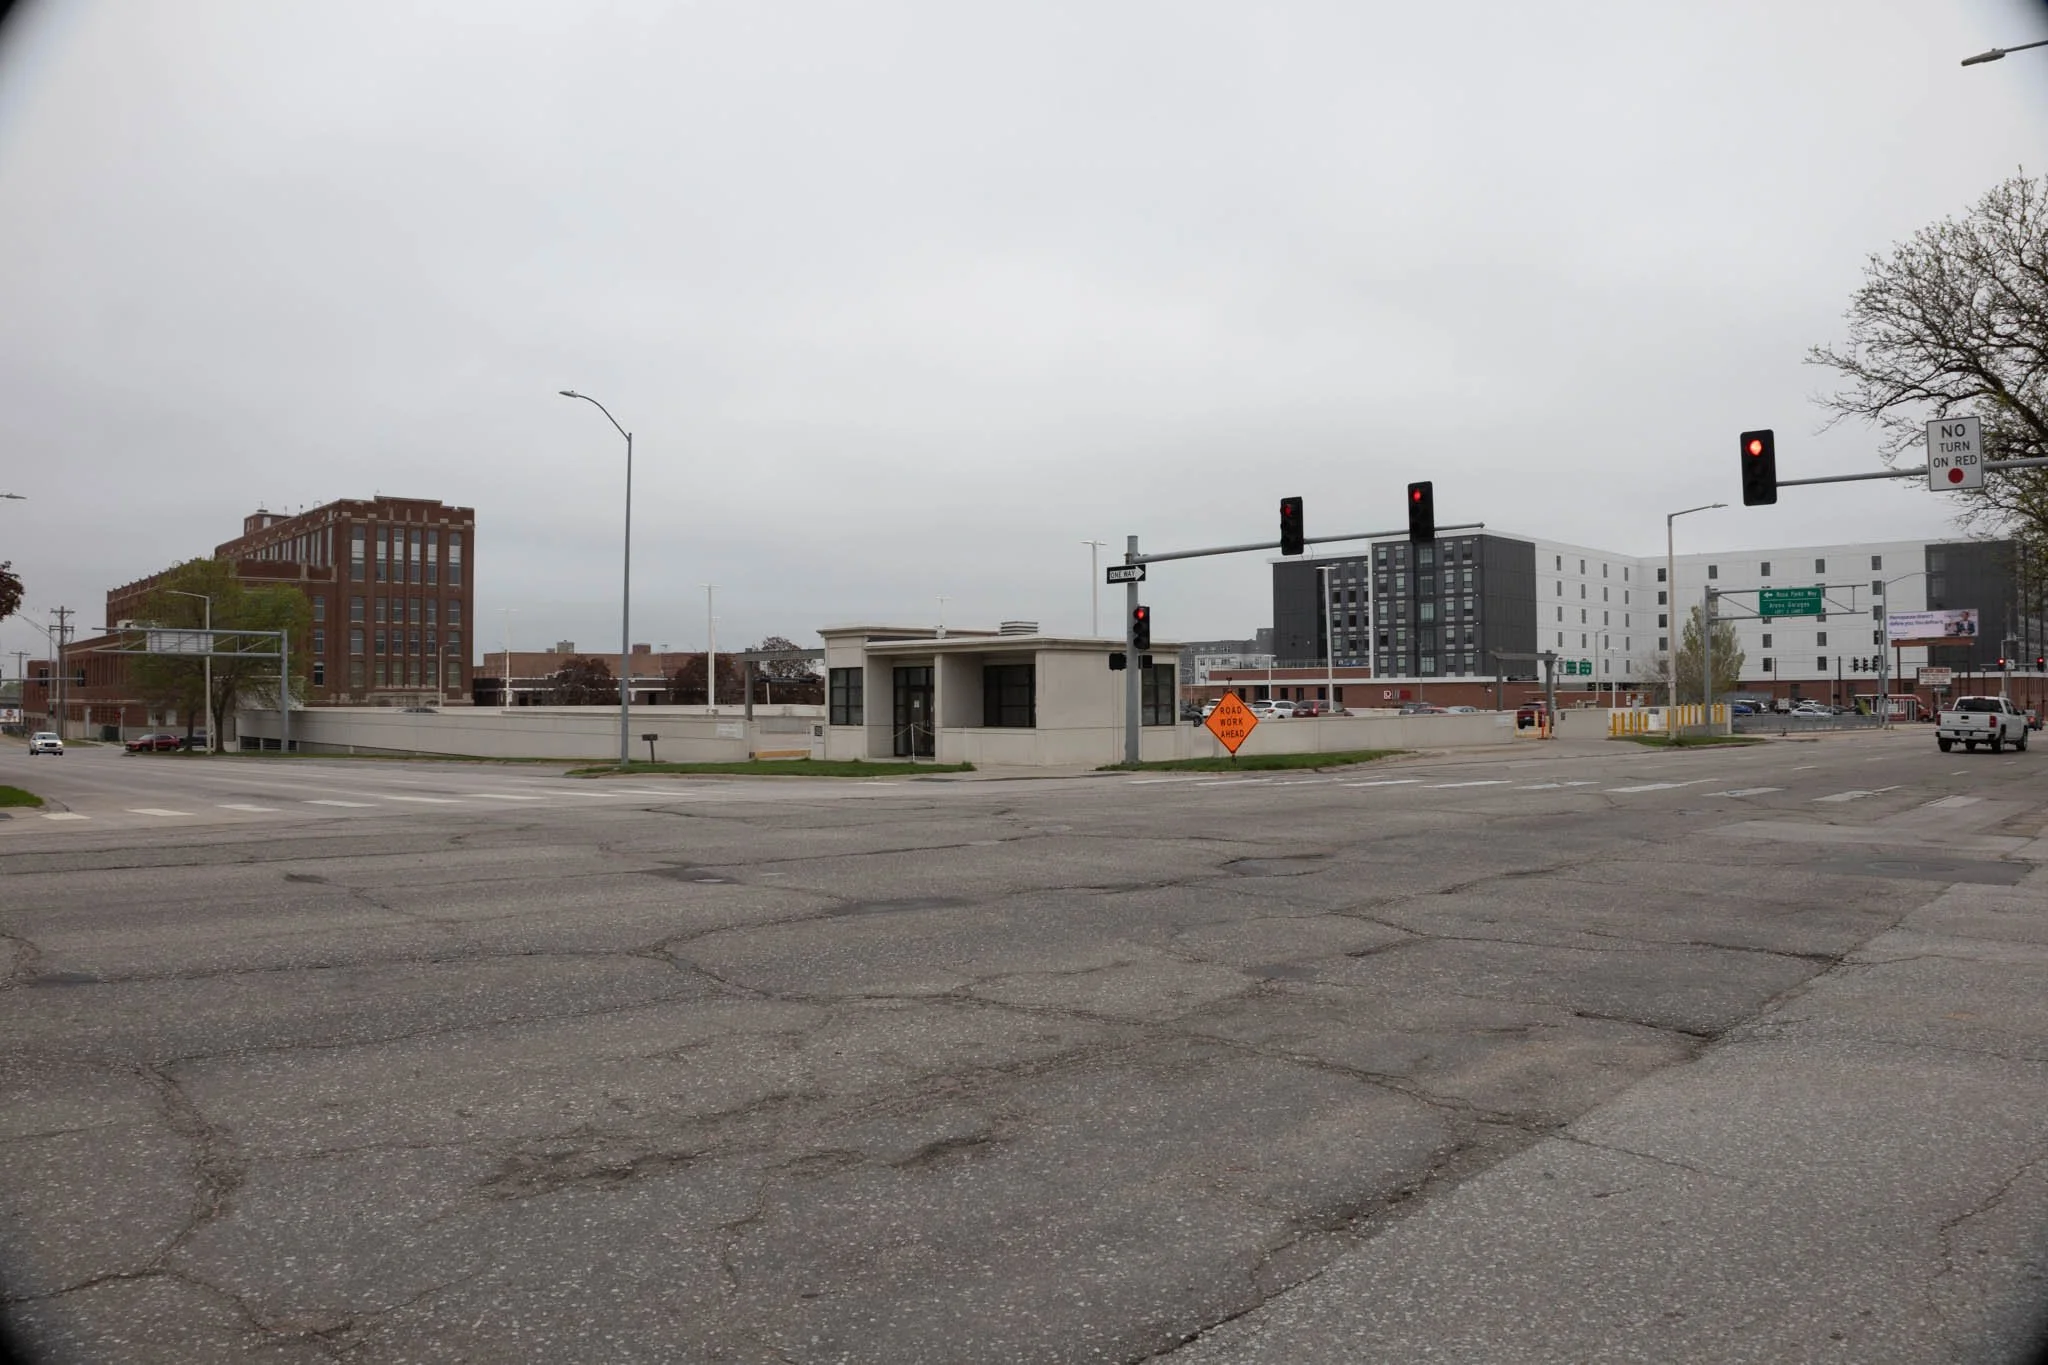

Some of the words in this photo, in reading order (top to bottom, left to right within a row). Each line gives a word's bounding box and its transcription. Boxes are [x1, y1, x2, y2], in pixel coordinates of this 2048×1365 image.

[1941, 424, 1965, 438] NO
[1939, 441, 1970, 453] TURN
[1933, 457, 1948, 468] ON
[1955, 455, 1977, 466] RED
[1124, 569, 1136, 577] WAY
[1220, 706, 1242, 714] ROAD
[1220, 718, 1243, 726] WORK
[1221, 730, 1244, 738] AHEAD
